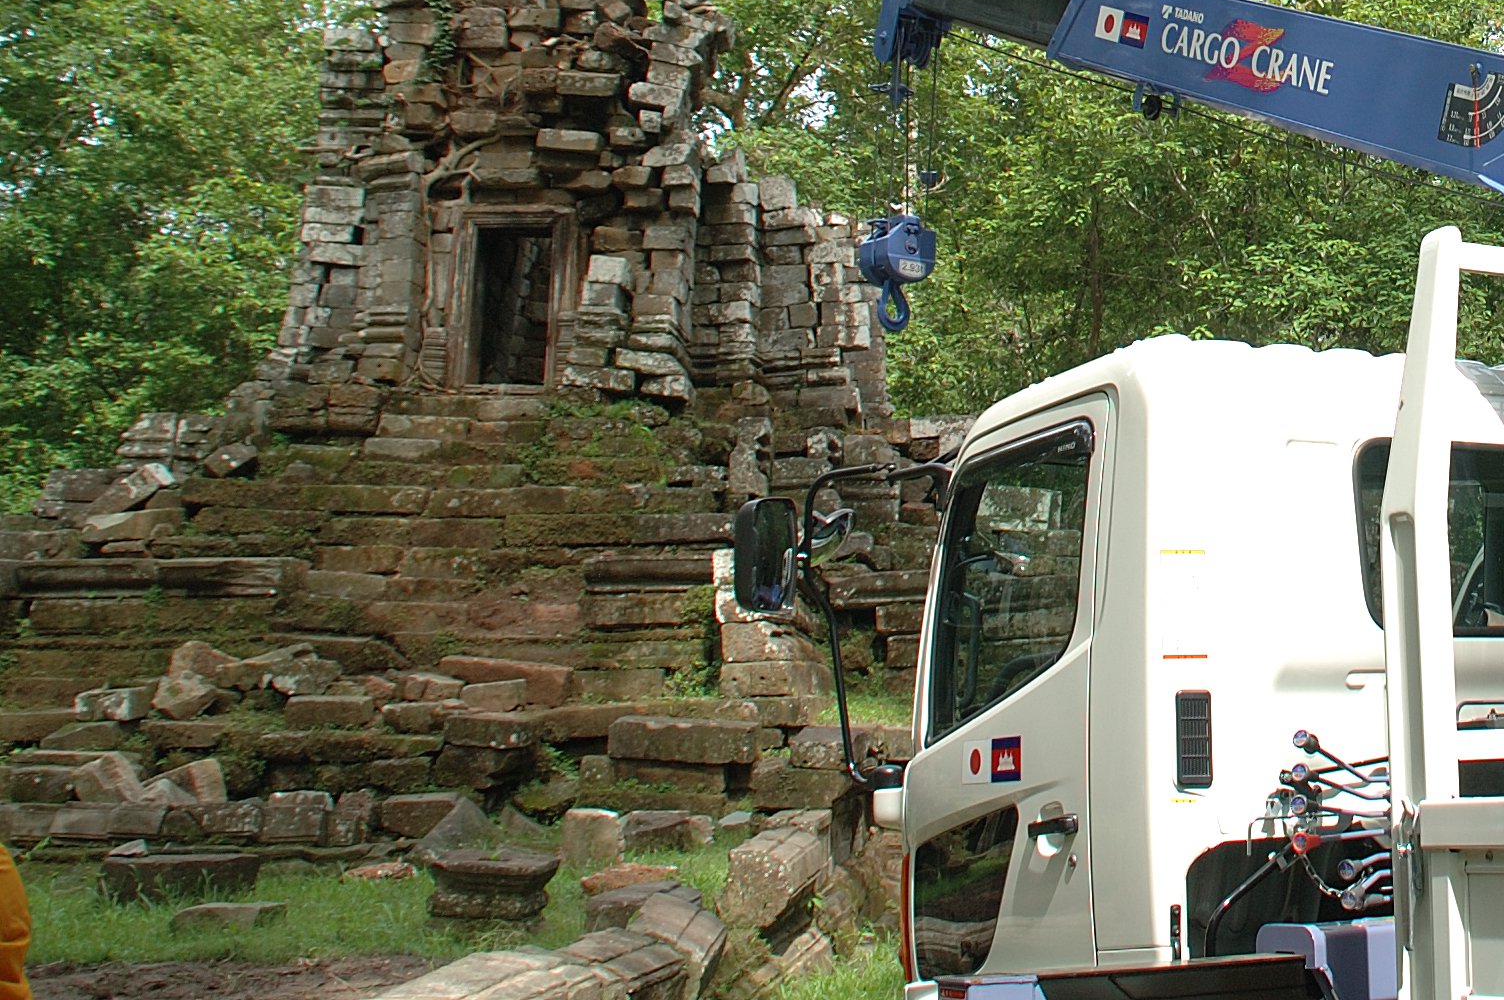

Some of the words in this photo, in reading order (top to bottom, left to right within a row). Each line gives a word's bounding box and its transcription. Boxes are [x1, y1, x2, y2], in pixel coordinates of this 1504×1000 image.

[1174, 7, 1204, 25] TADANO
[1161, 22, 1240, 69] CARGO
[1251, 45, 1335, 95] CRANE
[1057, 441, 1076, 453] HINO
